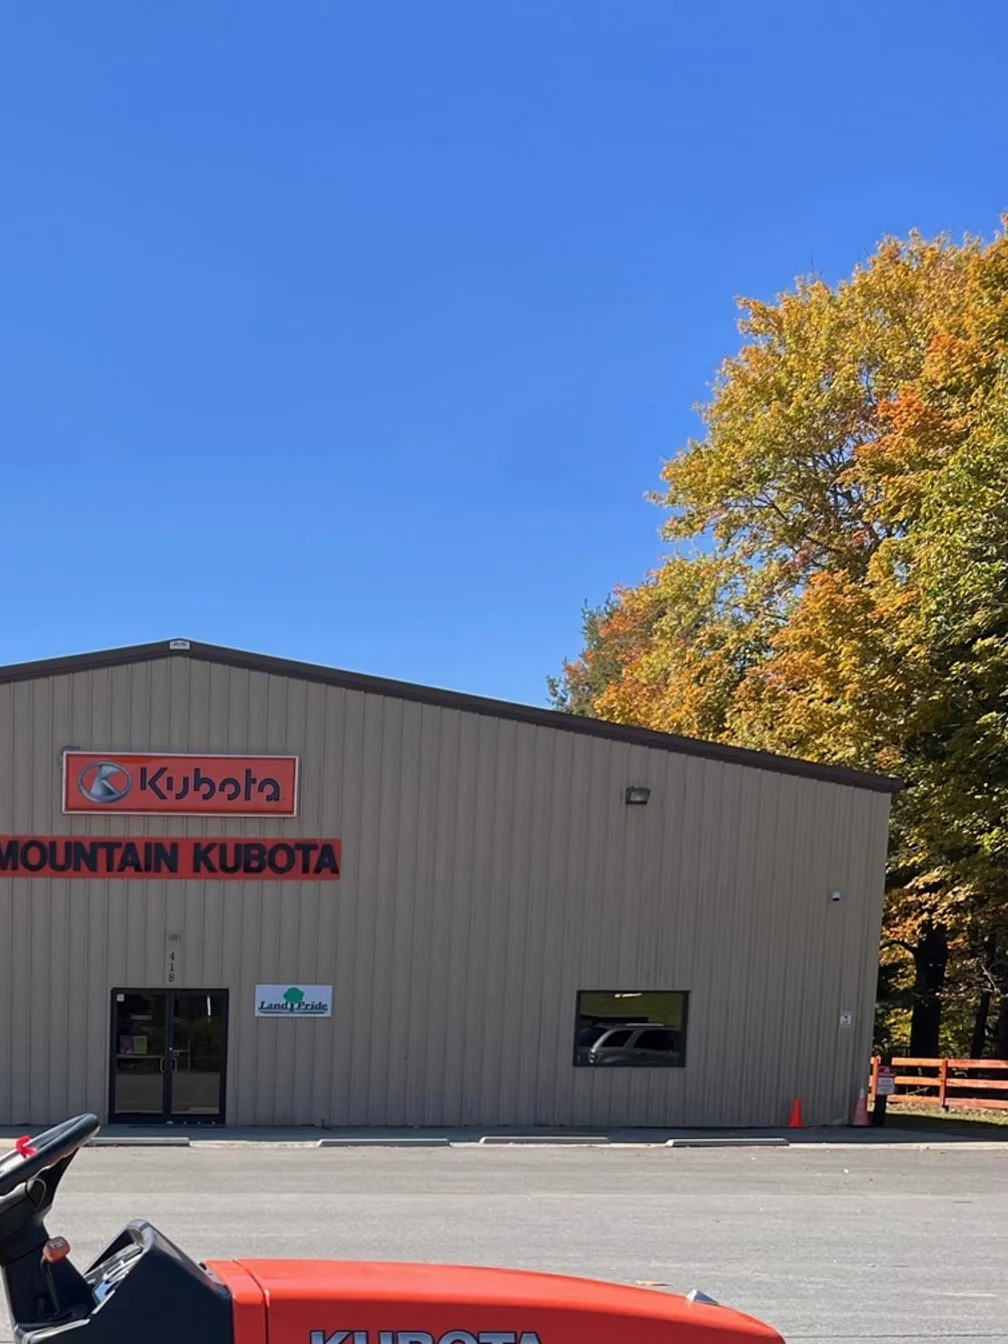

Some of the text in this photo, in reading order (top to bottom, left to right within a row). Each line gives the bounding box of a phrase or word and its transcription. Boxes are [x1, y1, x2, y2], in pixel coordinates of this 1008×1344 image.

[139, 767, 281, 802] Kubota
[192, 841, 341, 875] KUBOTA
[259, 1001, 328, 1011] Land Pride
